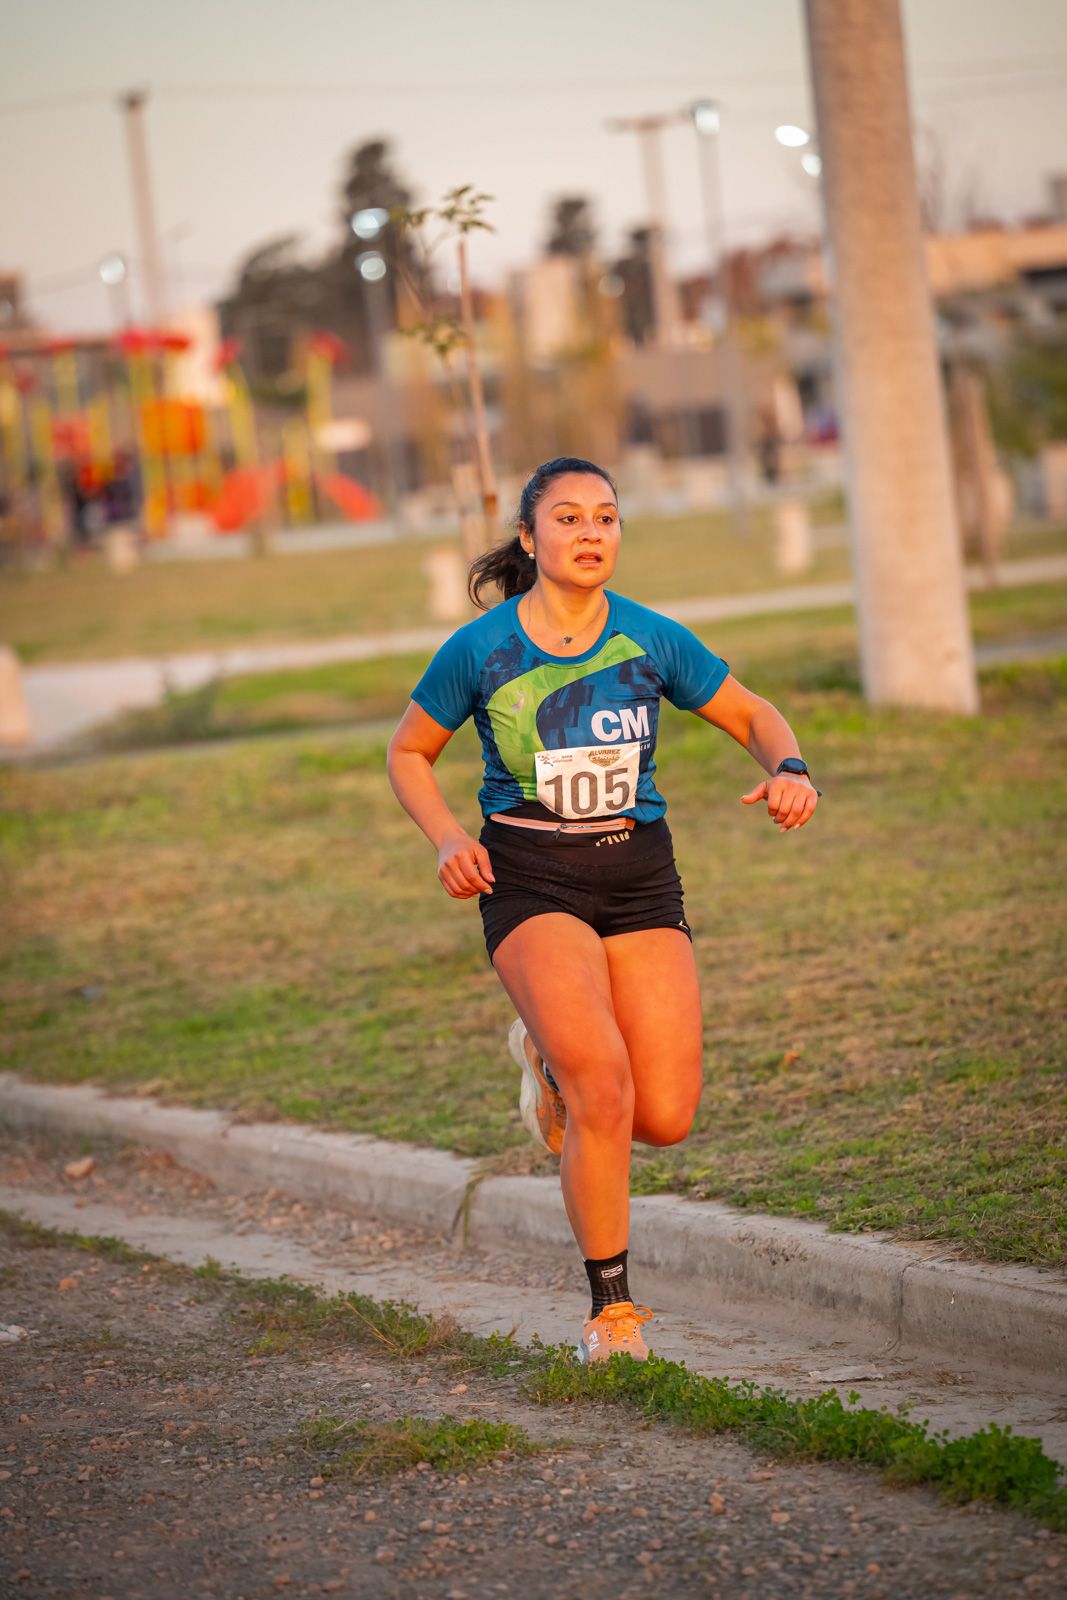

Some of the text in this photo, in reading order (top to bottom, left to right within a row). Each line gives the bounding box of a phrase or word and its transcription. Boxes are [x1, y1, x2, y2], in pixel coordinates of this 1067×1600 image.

[591, 705, 650, 742] CM
[589, 749, 621, 757] ALVAREZ
[544, 767, 630, 815] 105
